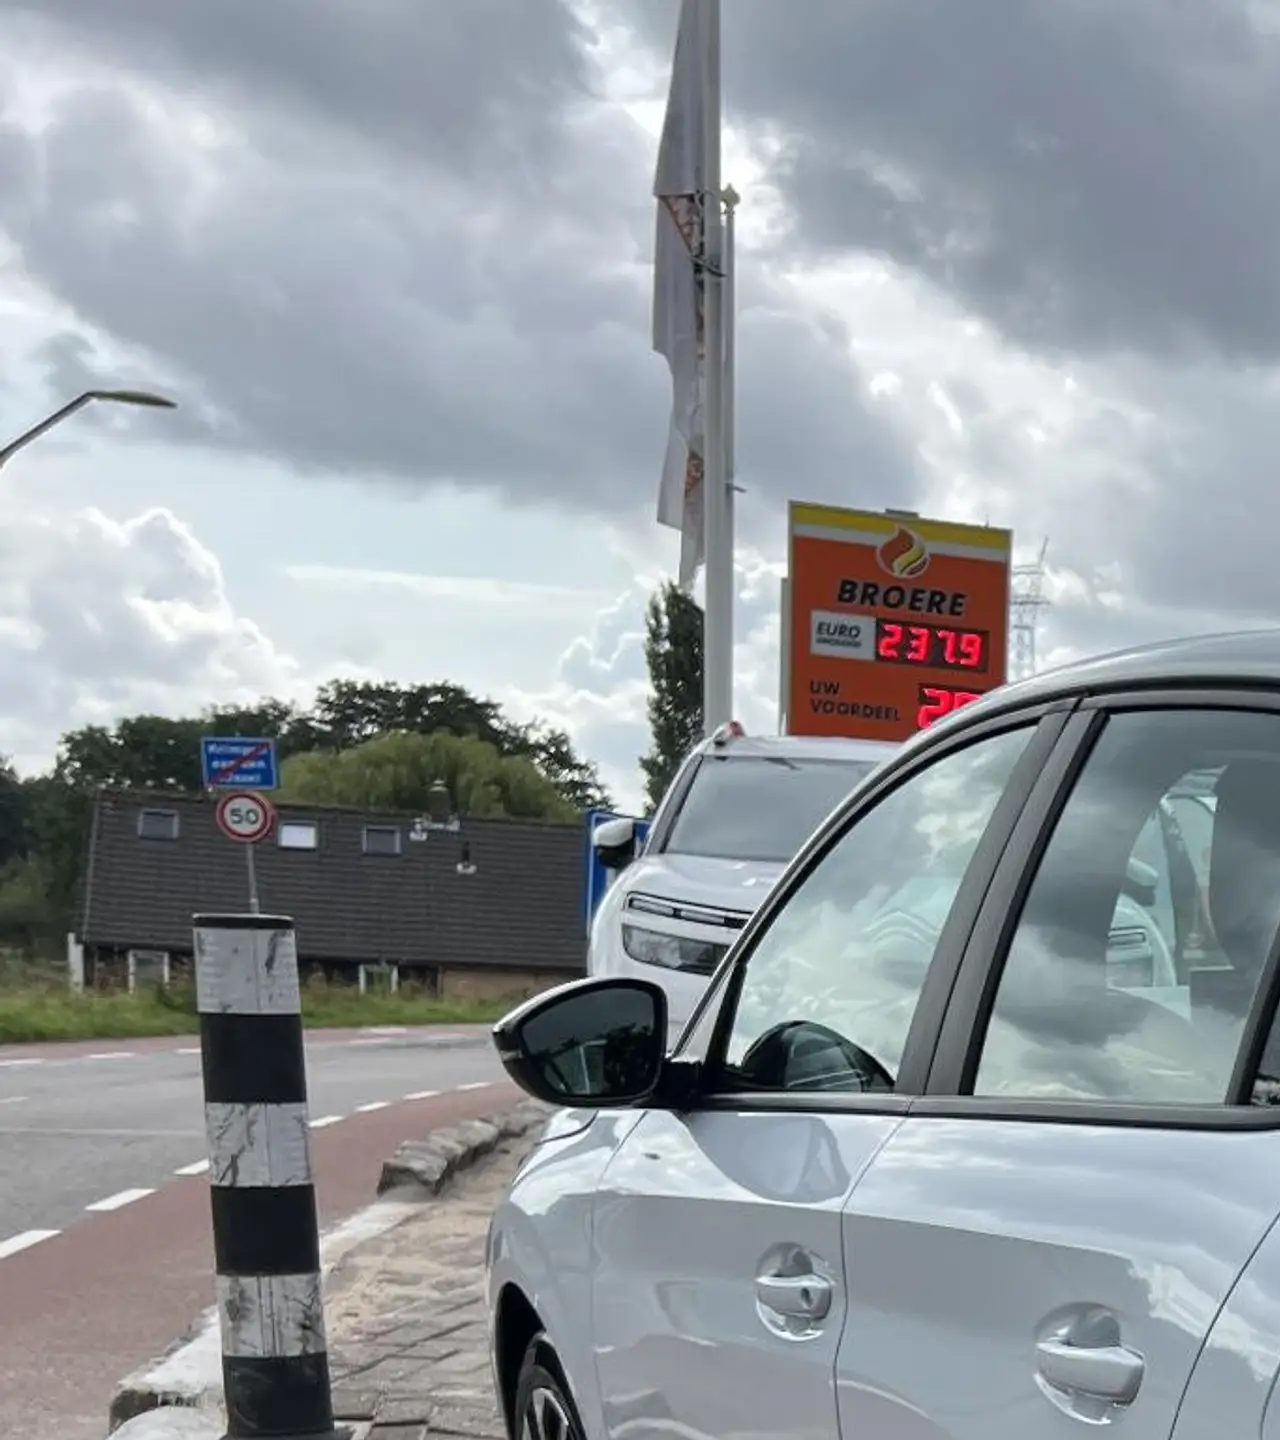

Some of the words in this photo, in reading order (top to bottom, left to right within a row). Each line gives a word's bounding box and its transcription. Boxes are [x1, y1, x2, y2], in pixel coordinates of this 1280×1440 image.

[837, 579, 967, 617] BROERE
[816, 621, 861, 638] EURO
[810, 680, 840, 695] UW
[811, 699, 901, 721] VOORDEEL
[230, 807, 259, 825] 50
